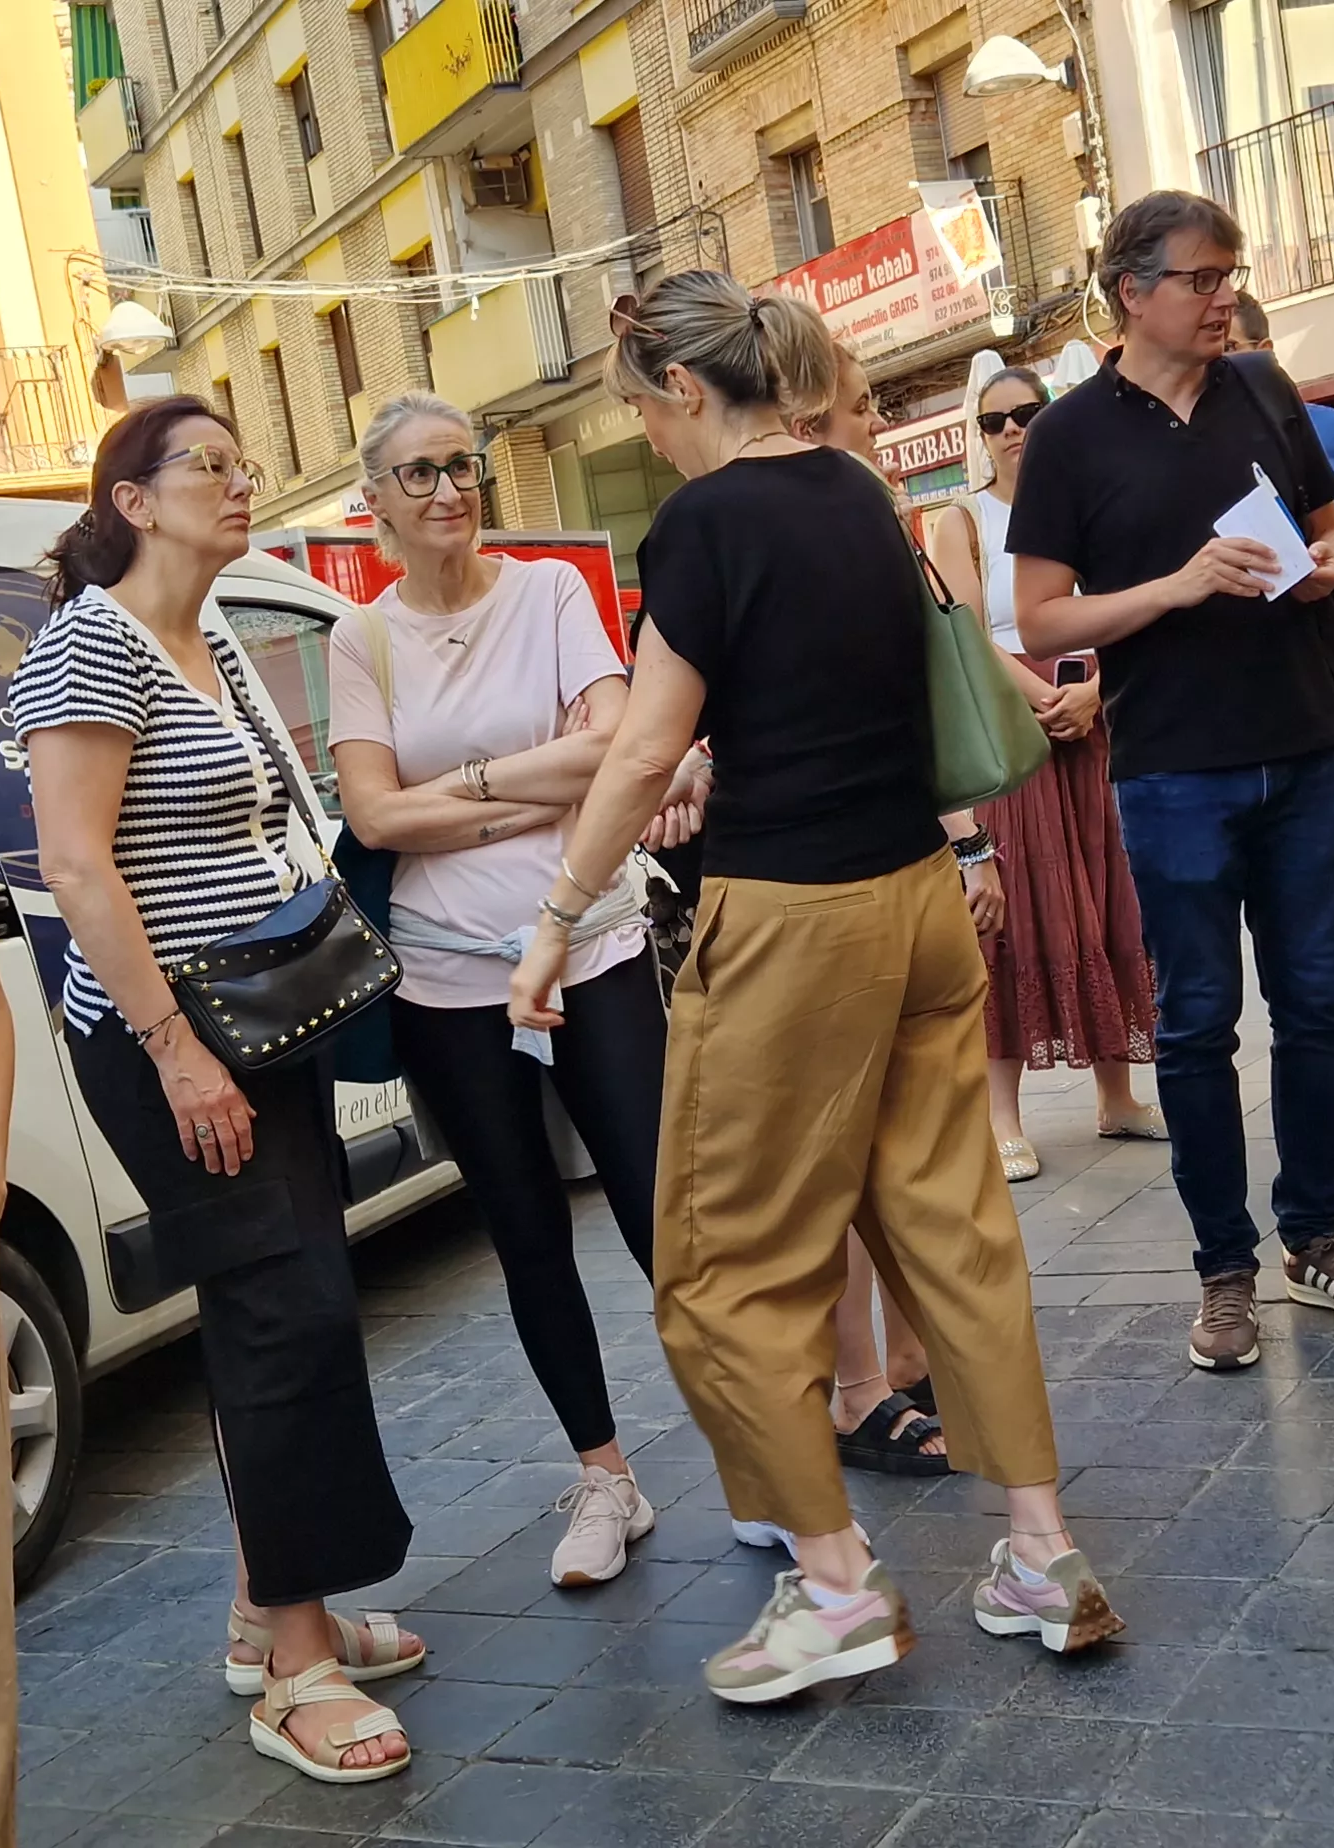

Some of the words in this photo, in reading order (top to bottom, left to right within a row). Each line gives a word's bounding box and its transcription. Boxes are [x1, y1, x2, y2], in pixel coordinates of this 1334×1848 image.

[823, 274, 864, 309] Döner
[866, 248, 913, 290] kebab
[889, 293, 919, 319] GRATIS
[897, 427, 965, 472] KEBAB
[350, 1096, 371, 1124] en
